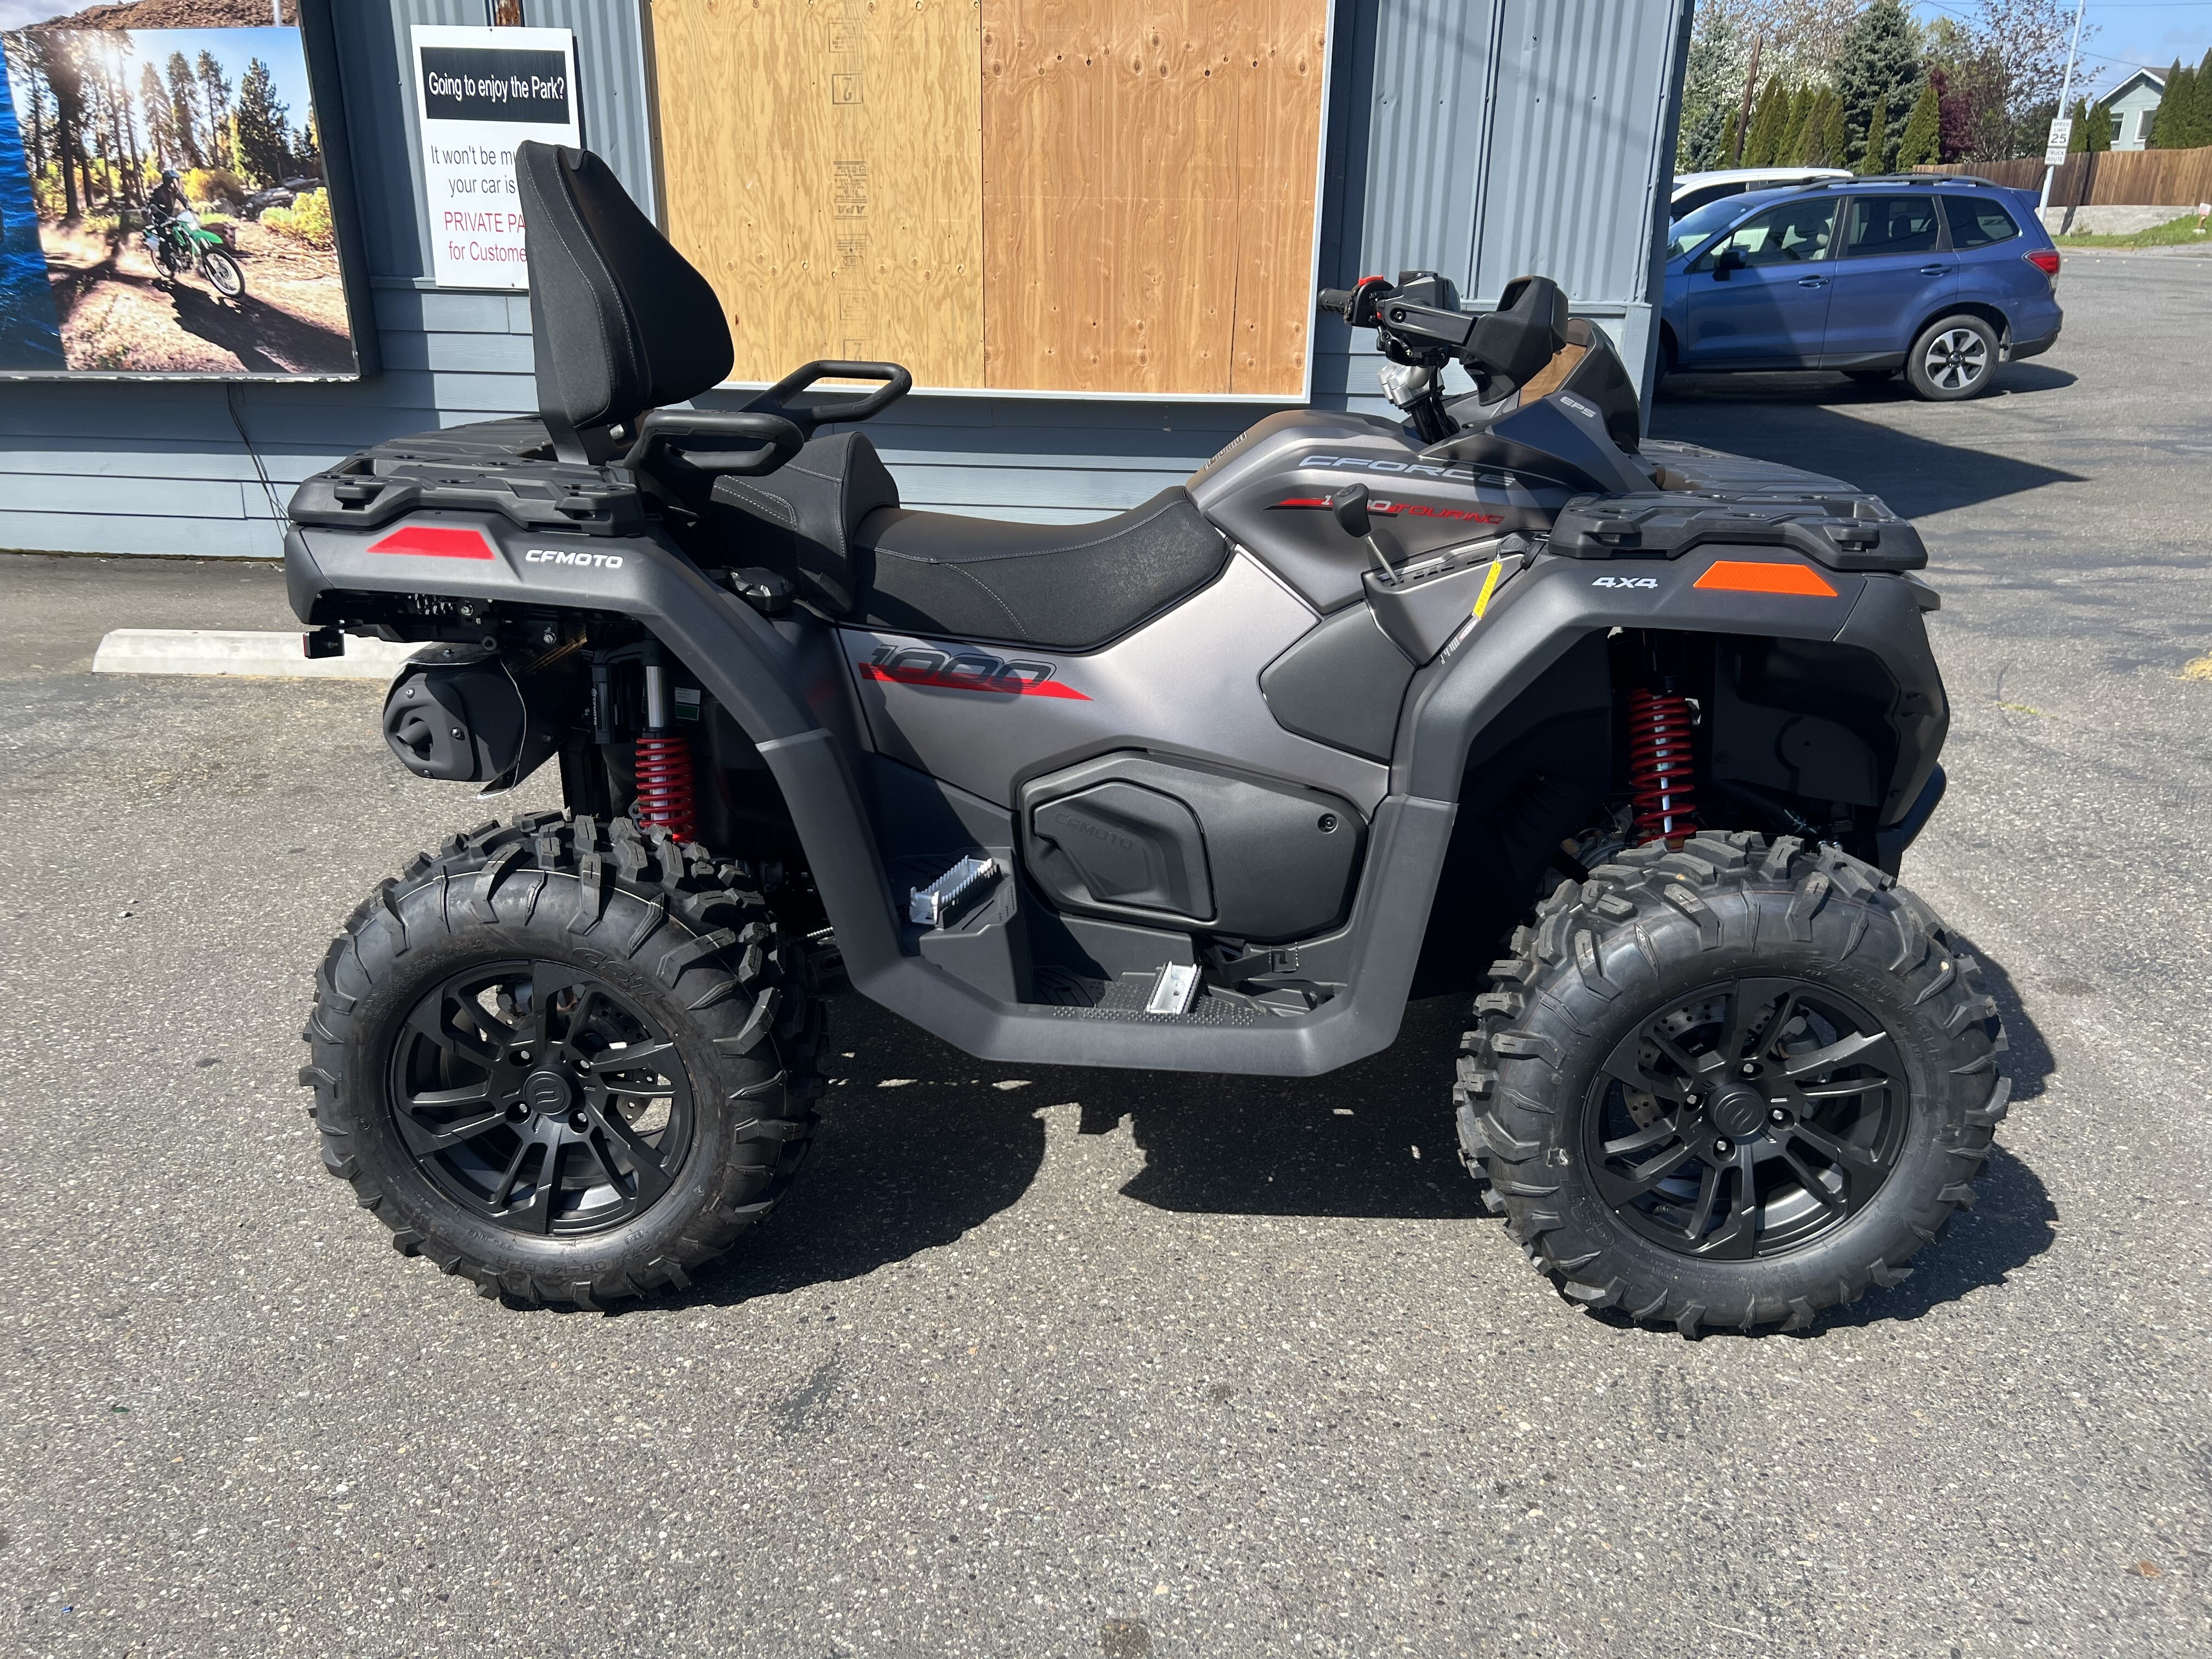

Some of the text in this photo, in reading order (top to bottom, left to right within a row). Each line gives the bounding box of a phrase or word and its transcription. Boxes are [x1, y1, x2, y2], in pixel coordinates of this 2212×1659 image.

[428, 72, 564, 103] Going to enjoy the Park?
[2051, 133, 2067, 143] 25
[431, 145, 439, 164] It
[442, 145, 477, 165] won't
[479, 145, 496, 165] be
[449, 174, 516, 198] your car is
[837, 205, 865, 215] APA
[444, 211, 504, 233] PRIVATE
[449, 241, 465, 261] for
[1560, 396, 1597, 417] EPS
[1299, 455, 1516, 486] CFORCE
[1395, 504, 1506, 524] TOURING
[525, 549, 623, 568] CFMOTO
[869, 644, 1057, 691] 1000
[1053, 810, 1135, 850] CFMOTO
[572, 947, 665, 998] CST
